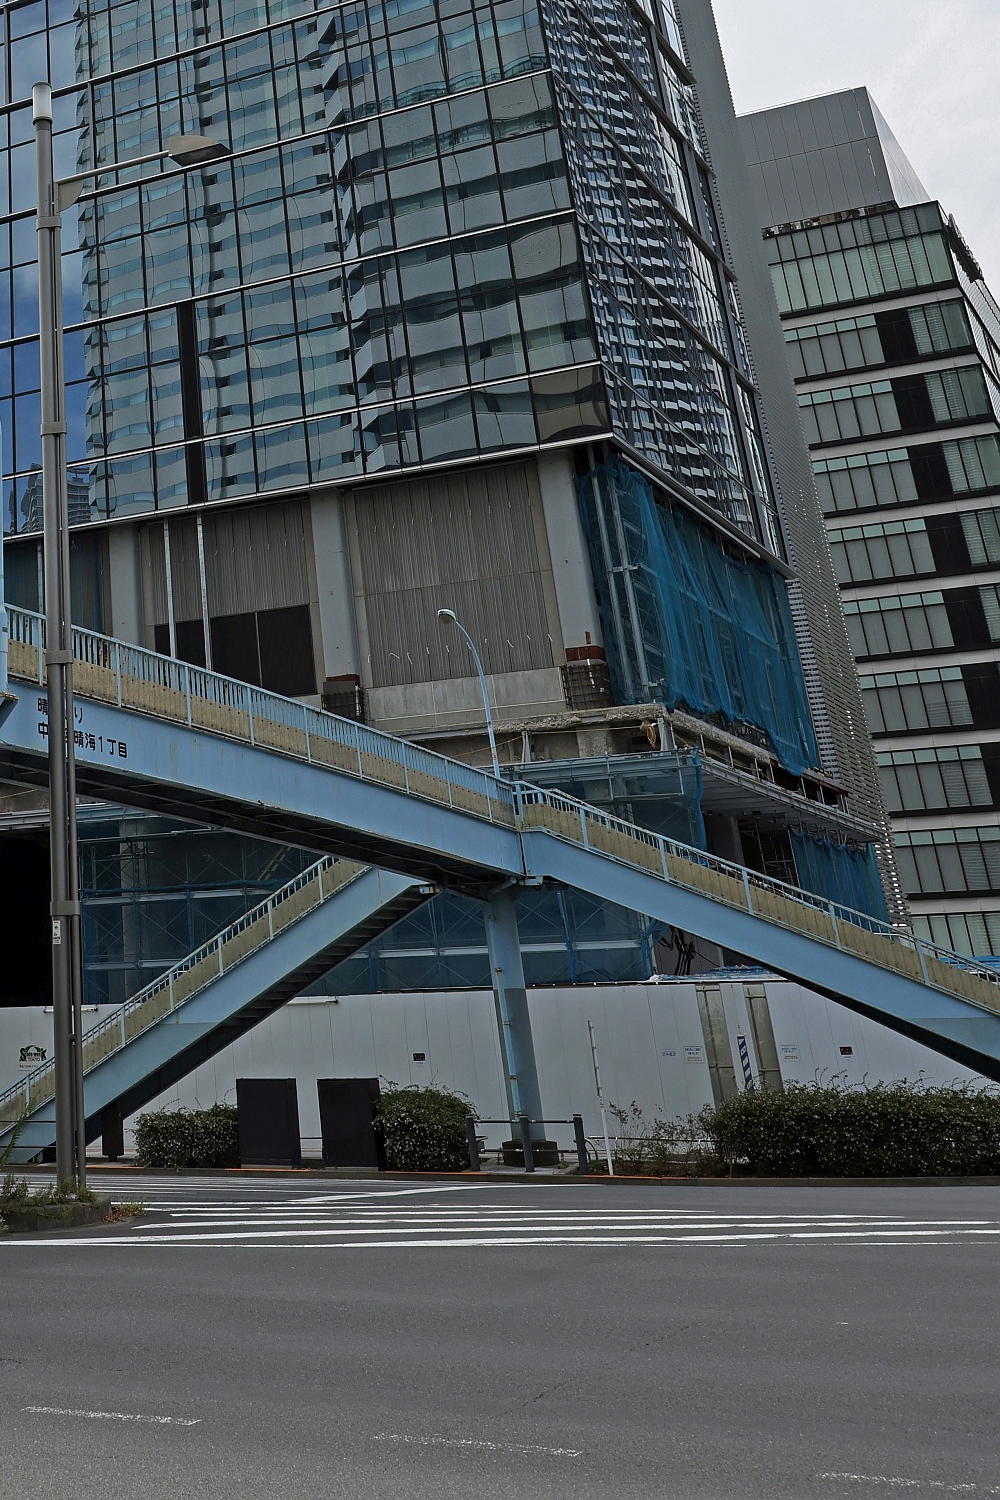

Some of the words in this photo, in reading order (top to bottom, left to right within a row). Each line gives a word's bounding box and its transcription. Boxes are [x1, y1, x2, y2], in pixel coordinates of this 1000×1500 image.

[37, 721, 128, 759] 中晴海1丁目
